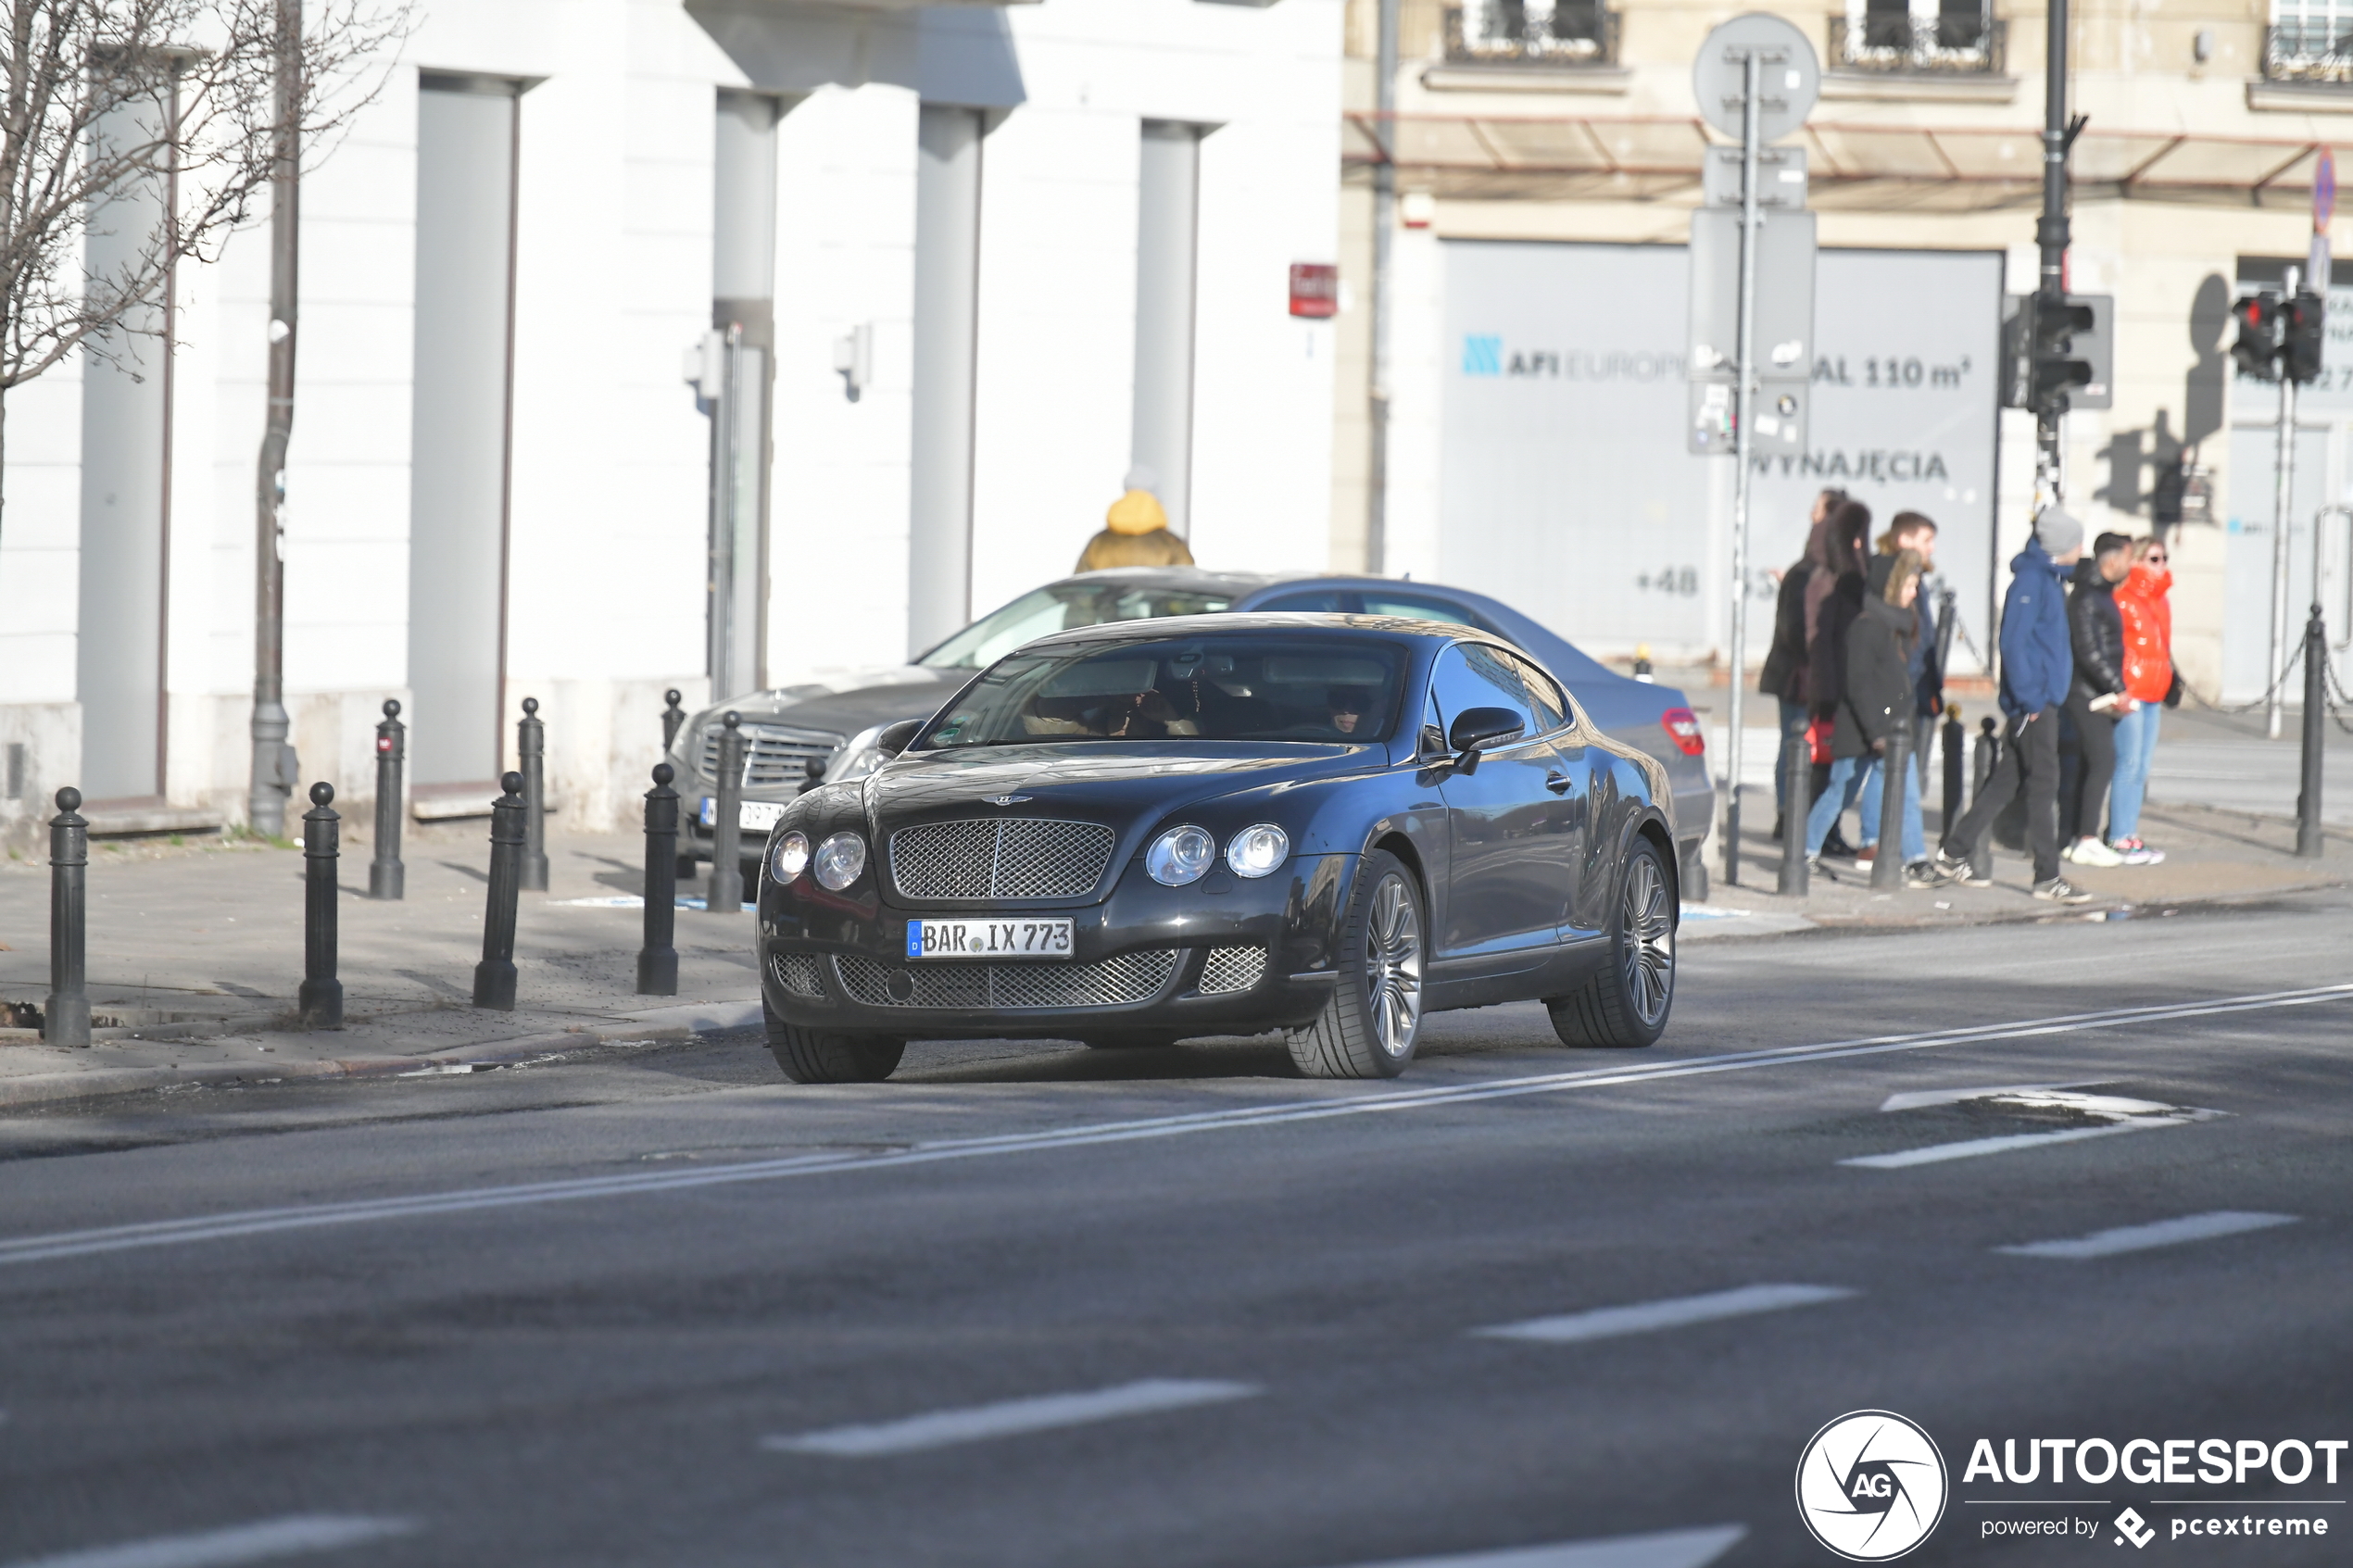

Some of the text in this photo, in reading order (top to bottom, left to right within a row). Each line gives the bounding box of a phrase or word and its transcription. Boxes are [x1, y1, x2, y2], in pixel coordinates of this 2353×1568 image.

[1508, 350, 1689, 382] AFI EUROP
[1864, 356, 1924, 388] 110
[1636, 566, 1699, 596] +48
[924, 923, 1070, 952] BAR IX 773
